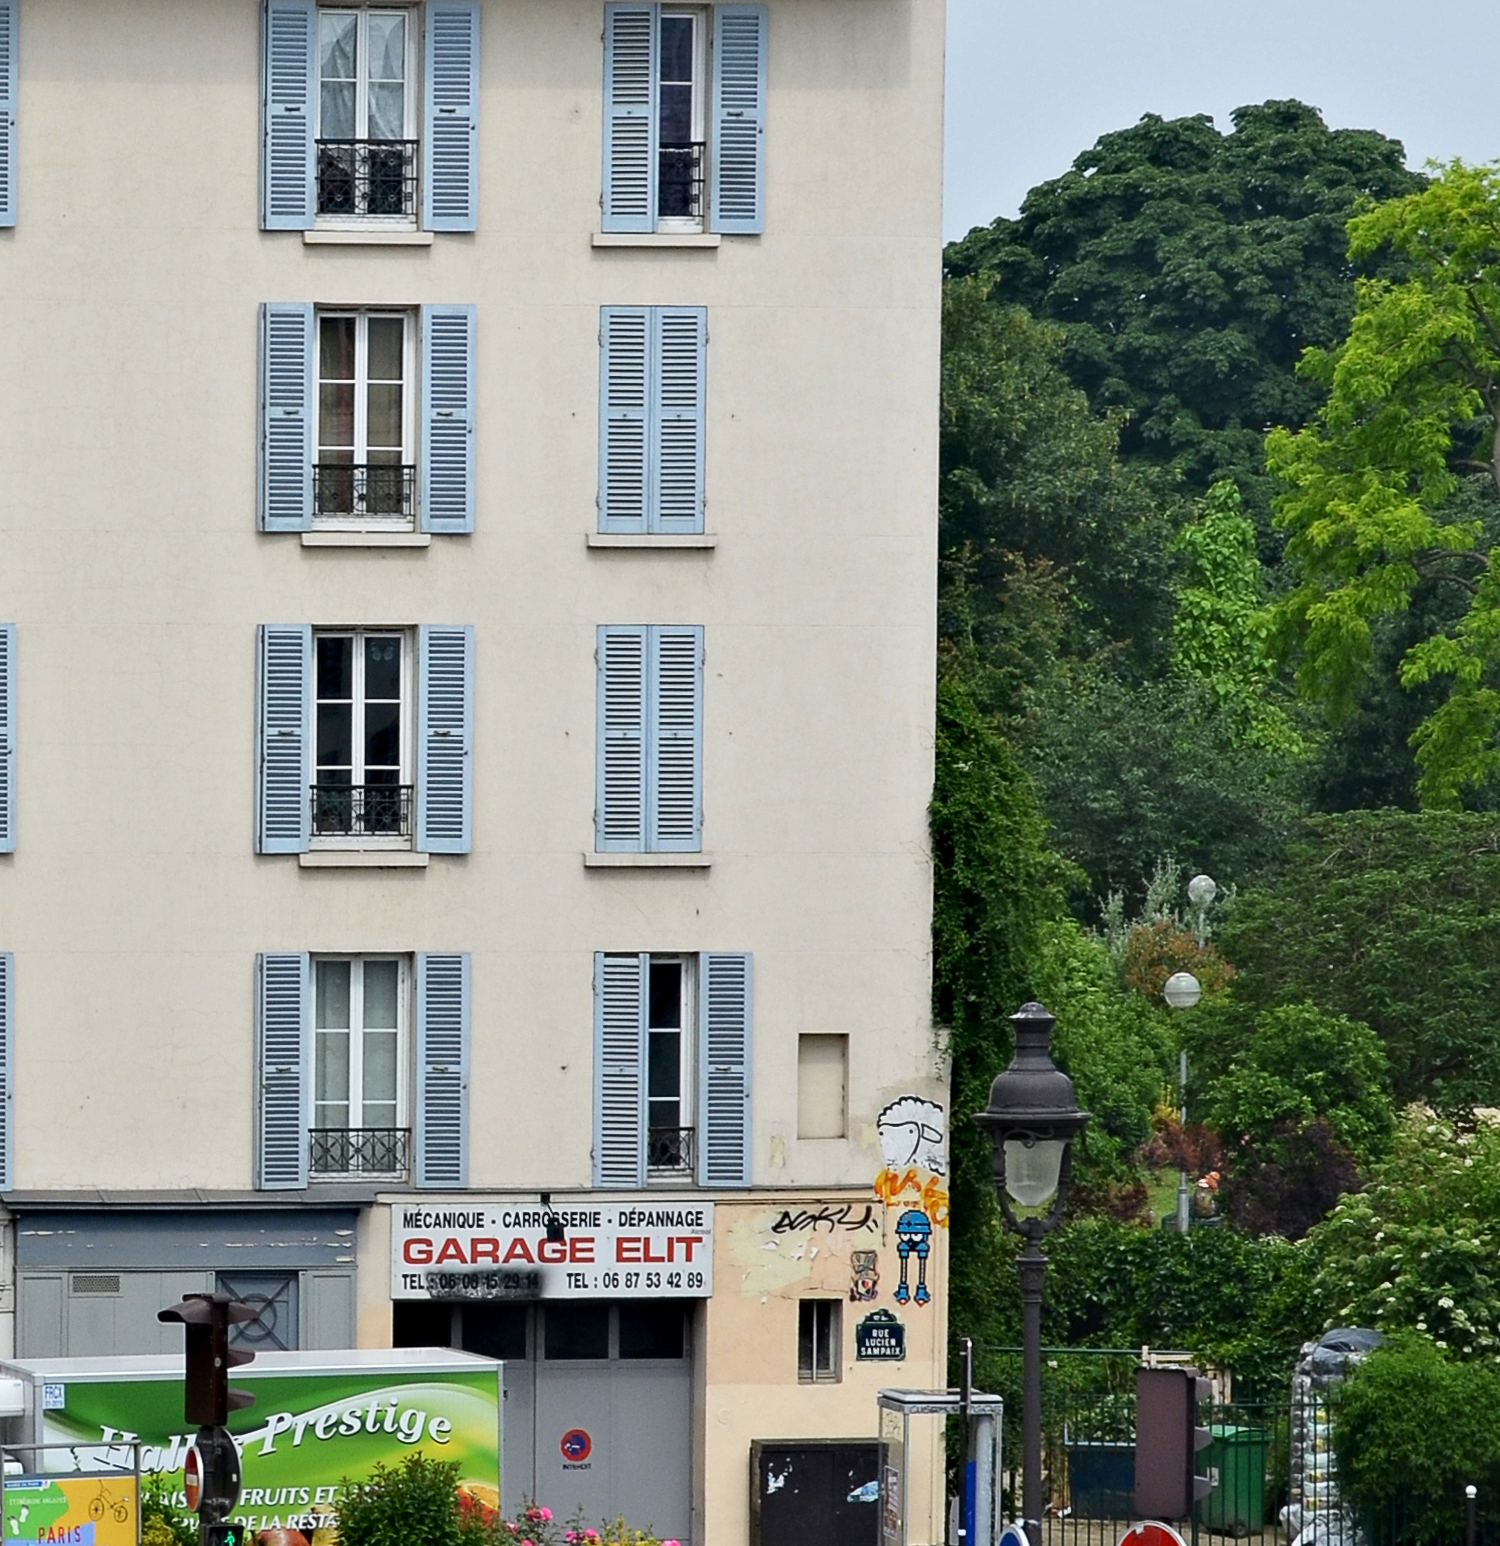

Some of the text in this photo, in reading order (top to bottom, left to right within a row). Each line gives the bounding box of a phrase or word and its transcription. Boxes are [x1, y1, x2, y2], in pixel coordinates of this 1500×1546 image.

[403, 1208, 485, 1229] MÉCANIQUE
[619, 1207, 704, 1227] DÉPANNAGE
[403, 1237, 703, 1264] GARAGE ELIT
[402, 1274, 425, 1290] TEL
[566, 1273, 589, 1289] TEL
[602, 1273, 619, 1289] 06
[625, 1273, 640, 1288] 87
[645, 1273, 661, 1289] 53
[667, 1272, 682, 1288] 42
[687, 1272, 704, 1288] 89
[871, 1328, 890, 1338] RUE
[860, 1347, 901, 1356] SAMPAIX
[865, 1338, 896, 1347] LUCIEN
[92, 1396, 453, 1474] Halls Prestige
[239, 1486, 311, 1506] FRUITS
[314, 1485, 339, 1504] ET
[233, 1515, 258, 1531] DE
[260, 1514, 282, 1531] LA
[286, 1513, 340, 1531] RESTA
[38, 1525, 82, 1545] PARIS
